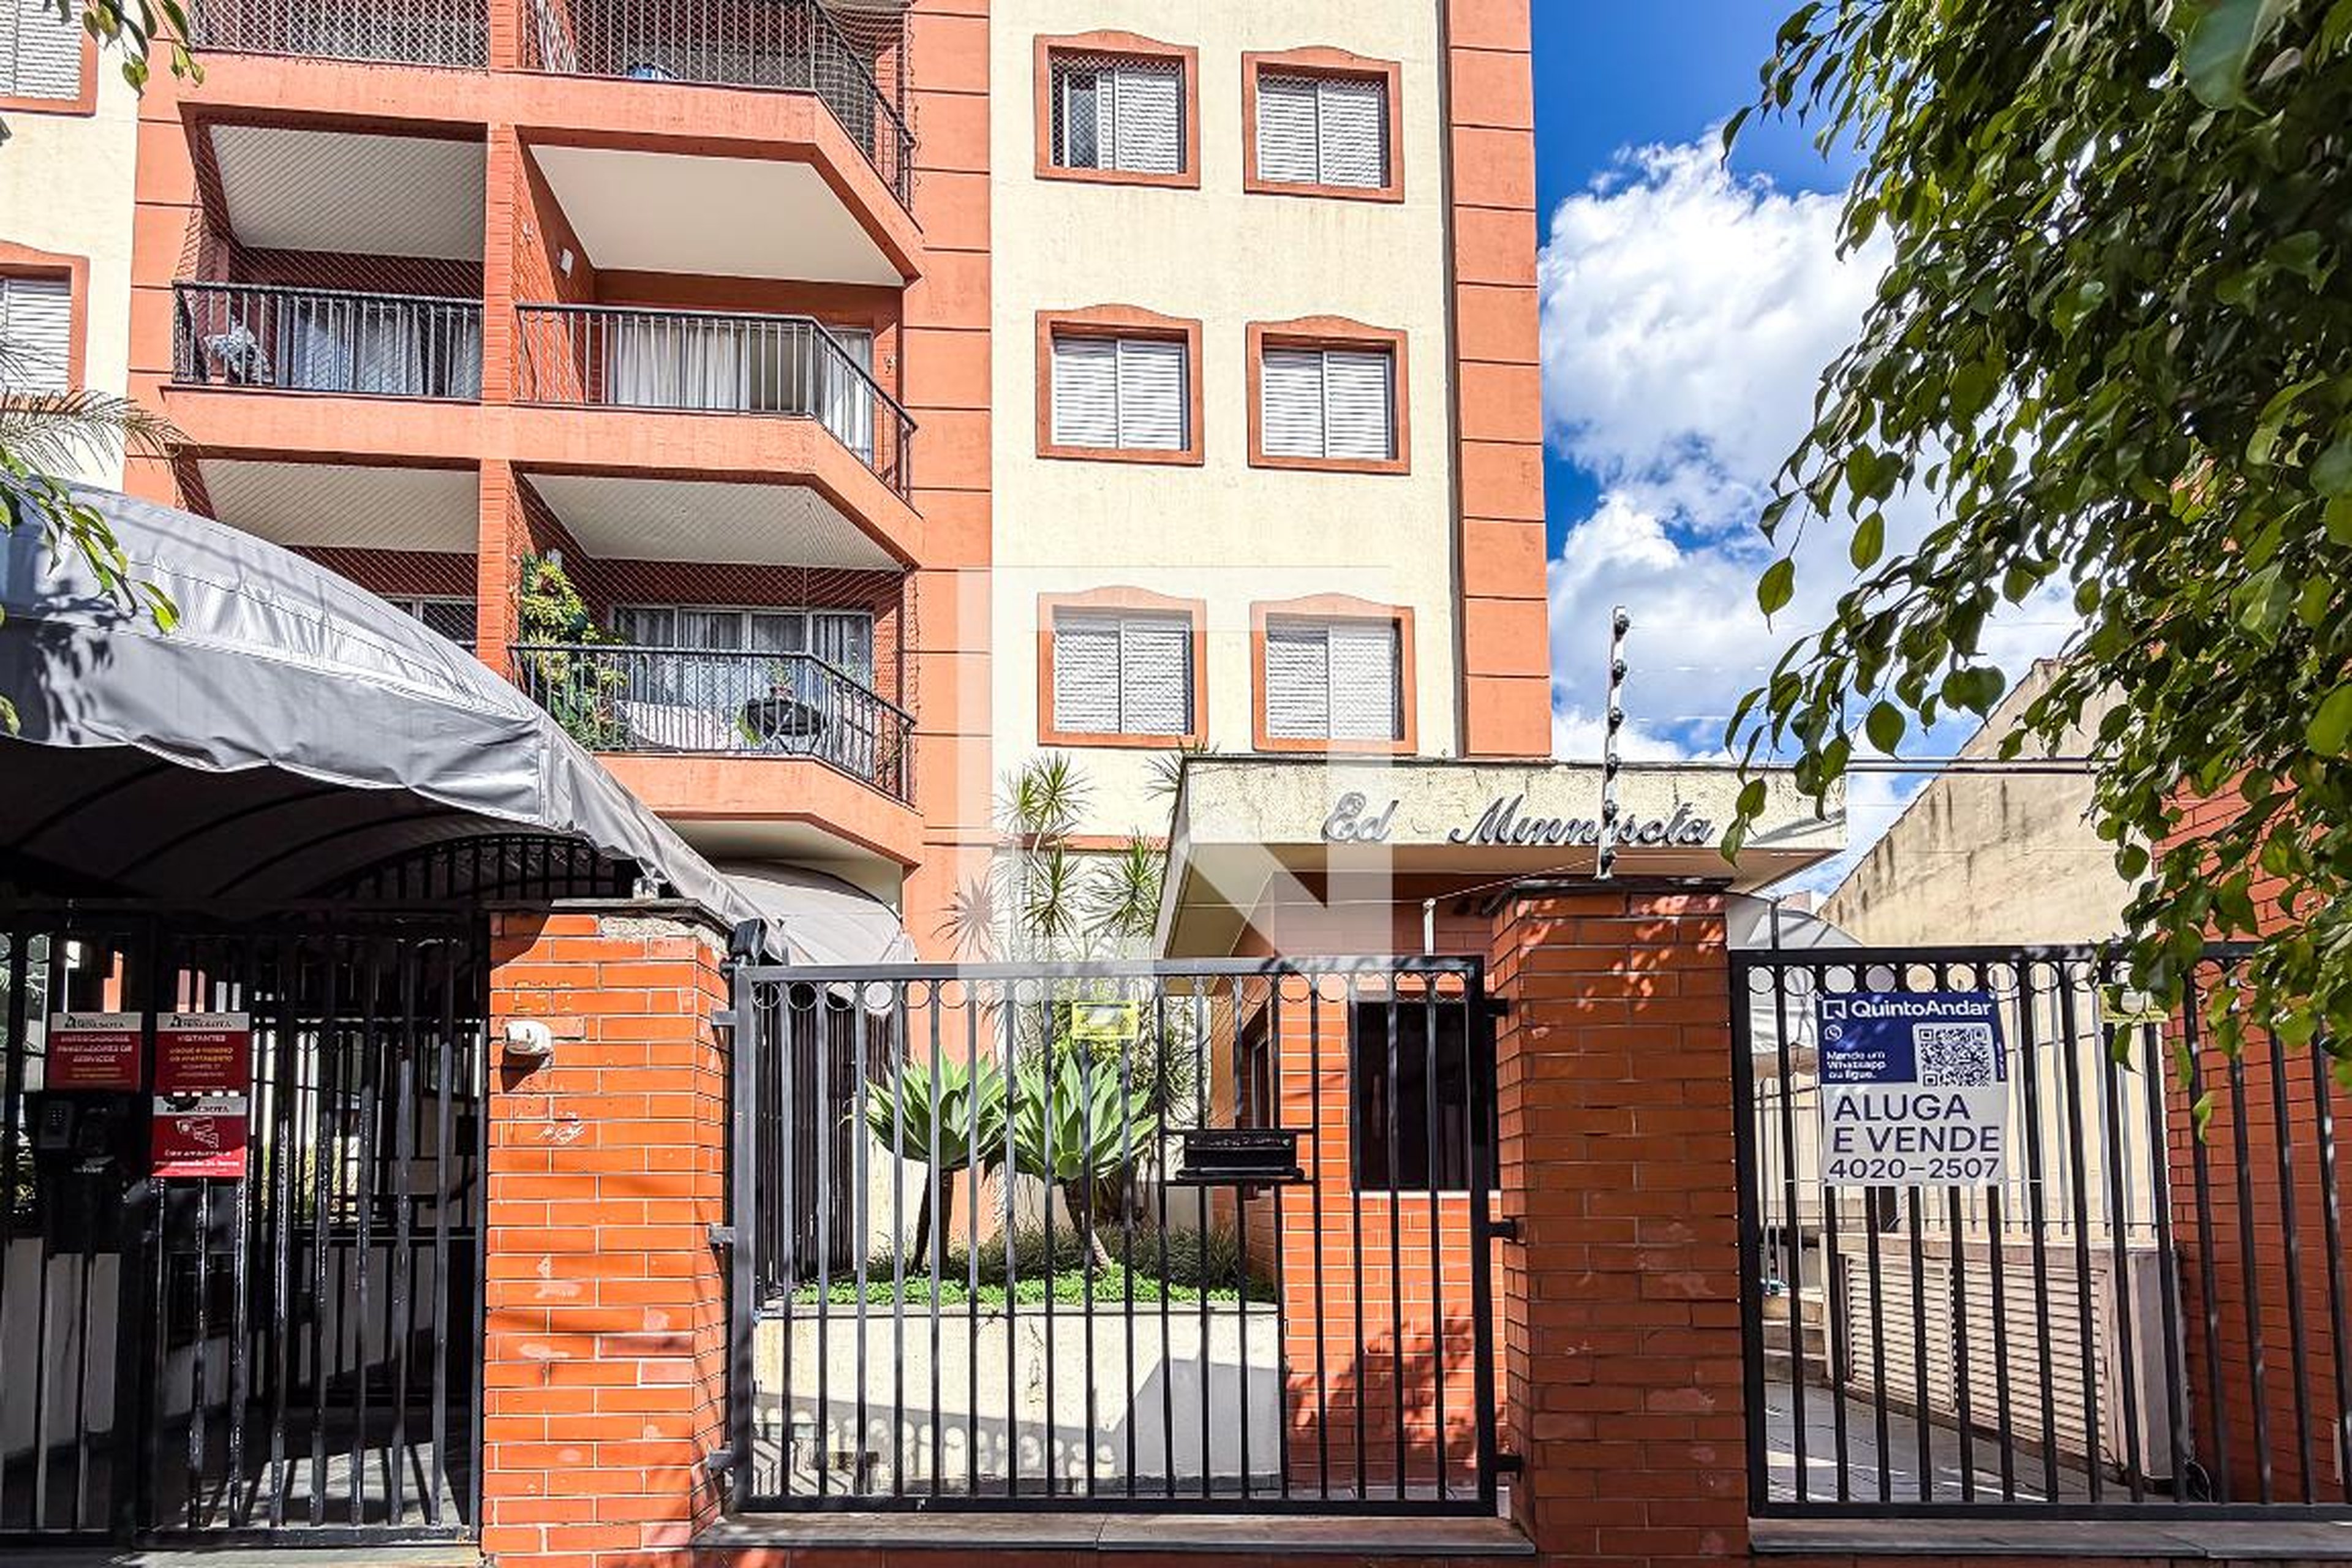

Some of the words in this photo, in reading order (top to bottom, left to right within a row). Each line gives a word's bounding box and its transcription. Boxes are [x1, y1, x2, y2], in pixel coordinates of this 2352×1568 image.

[1321, 792, 1399, 842] Ed
[1449, 794, 1714, 845] Minnsota
[1851, 1000, 1992, 1017] QuintoAndar
[1826, 1051, 1864, 1060] Mande
[1833, 1094, 1971, 1121] ALUGA
[1833, 1128, 1853, 1153] E
[1866, 1126, 2000, 1153] VENDE
[1828, 1158, 2000, 1179] 4020-2507
